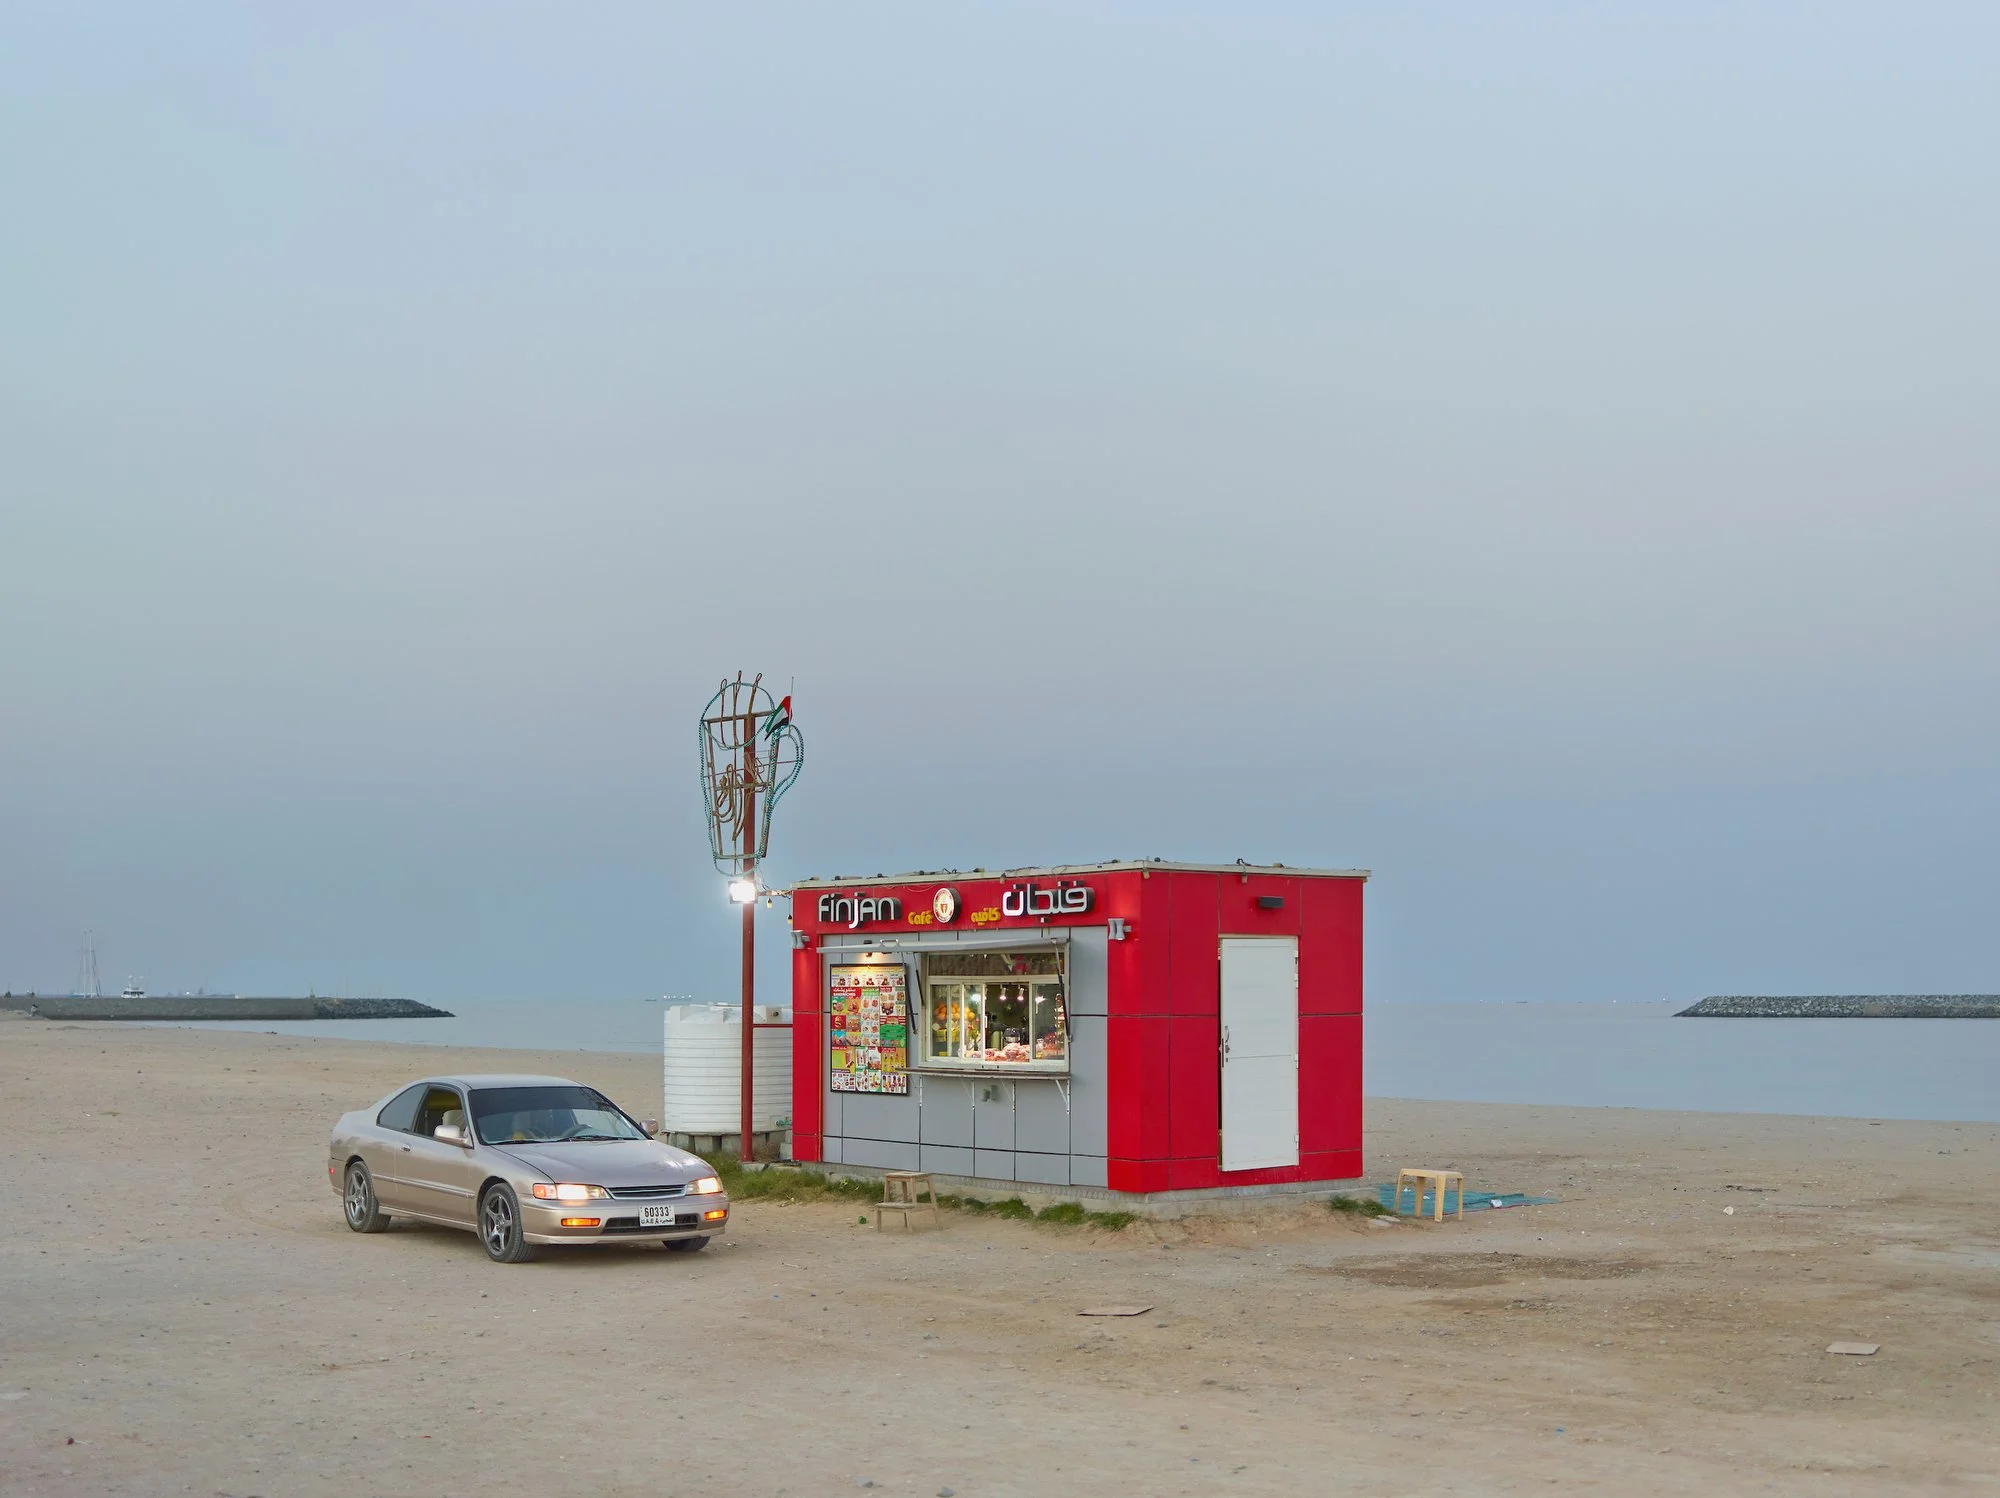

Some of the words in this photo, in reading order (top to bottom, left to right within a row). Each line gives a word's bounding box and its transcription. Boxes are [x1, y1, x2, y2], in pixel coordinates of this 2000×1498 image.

[1002, 880, 1088, 923] فنجان
[907, 910, 933, 925] Café
[644, 1206, 669, 1217] 60333
